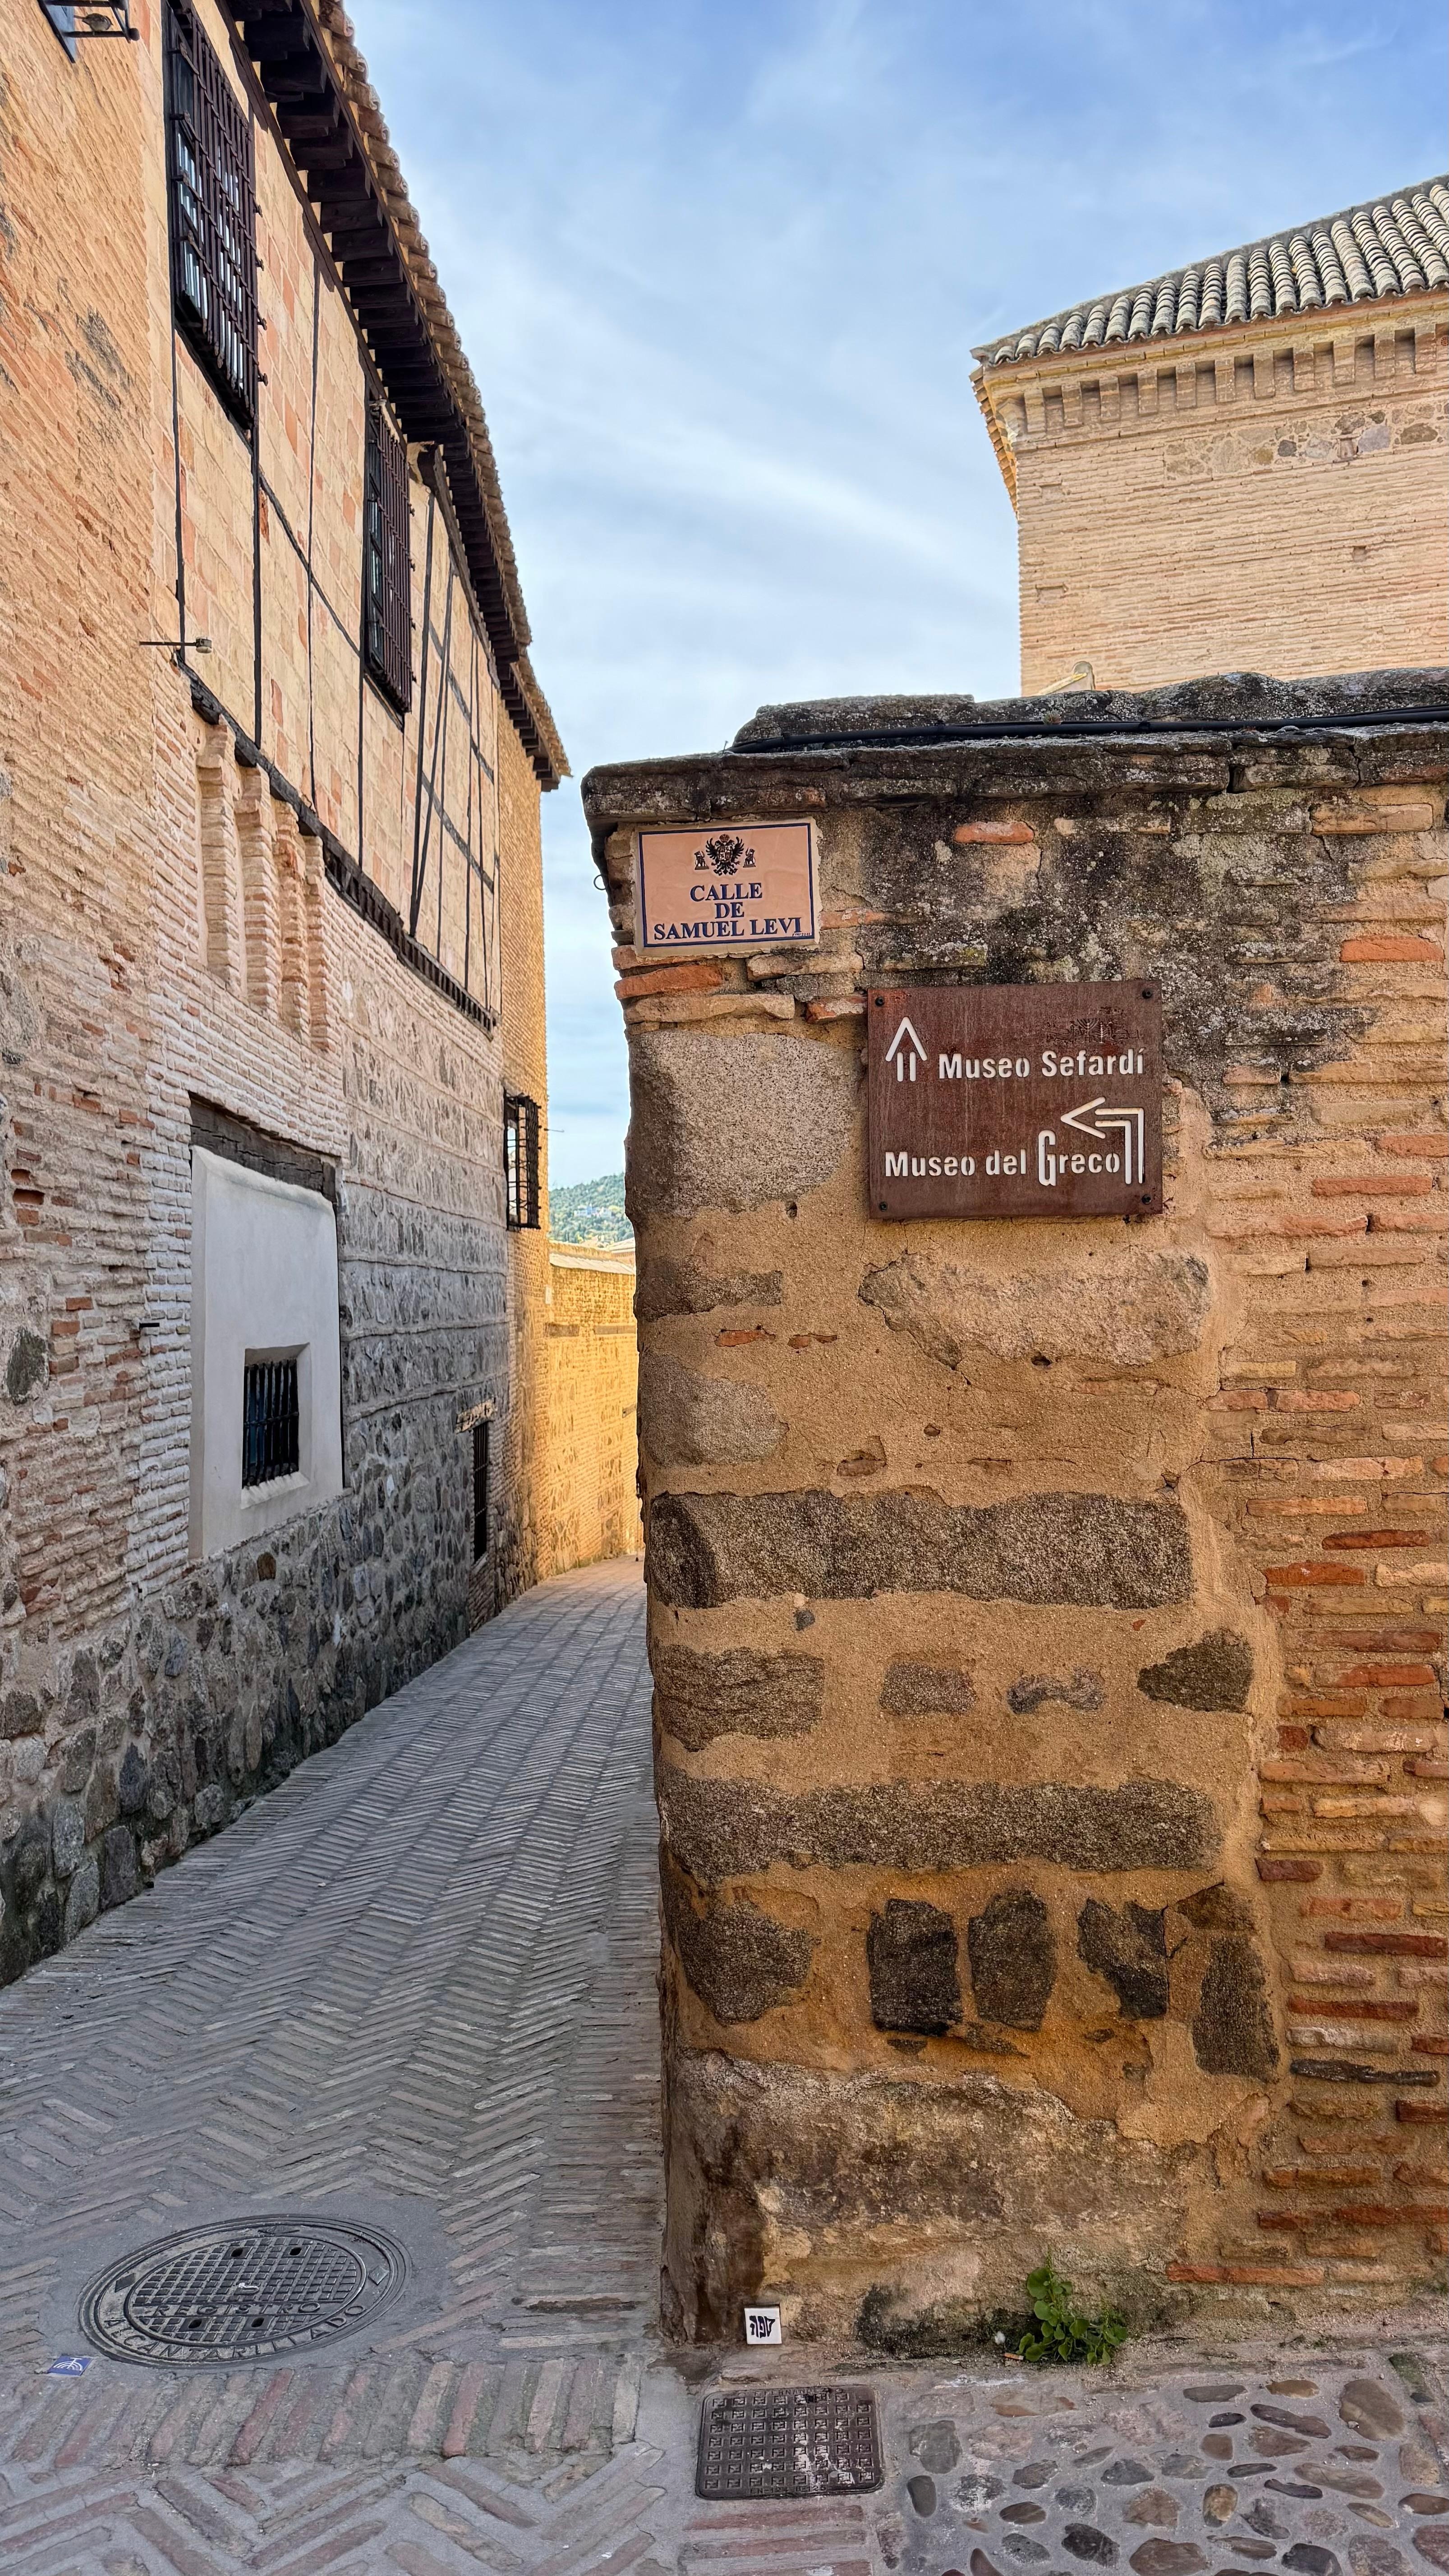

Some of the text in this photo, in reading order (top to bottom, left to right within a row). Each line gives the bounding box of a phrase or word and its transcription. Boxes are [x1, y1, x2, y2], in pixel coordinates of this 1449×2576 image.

[690, 882, 763, 902] CALLE
[715, 902, 745, 919] DE
[654, 917, 801, 940] SAMUEL LEVI
[938, 1048, 1145, 1079] Museo Sefardí
[885, 1129, 1121, 1187] Museo del Greco
[152, 2302, 321, 2316] REGISTRO
[104, 2305, 366, 2361] ALCANTARILLADO
